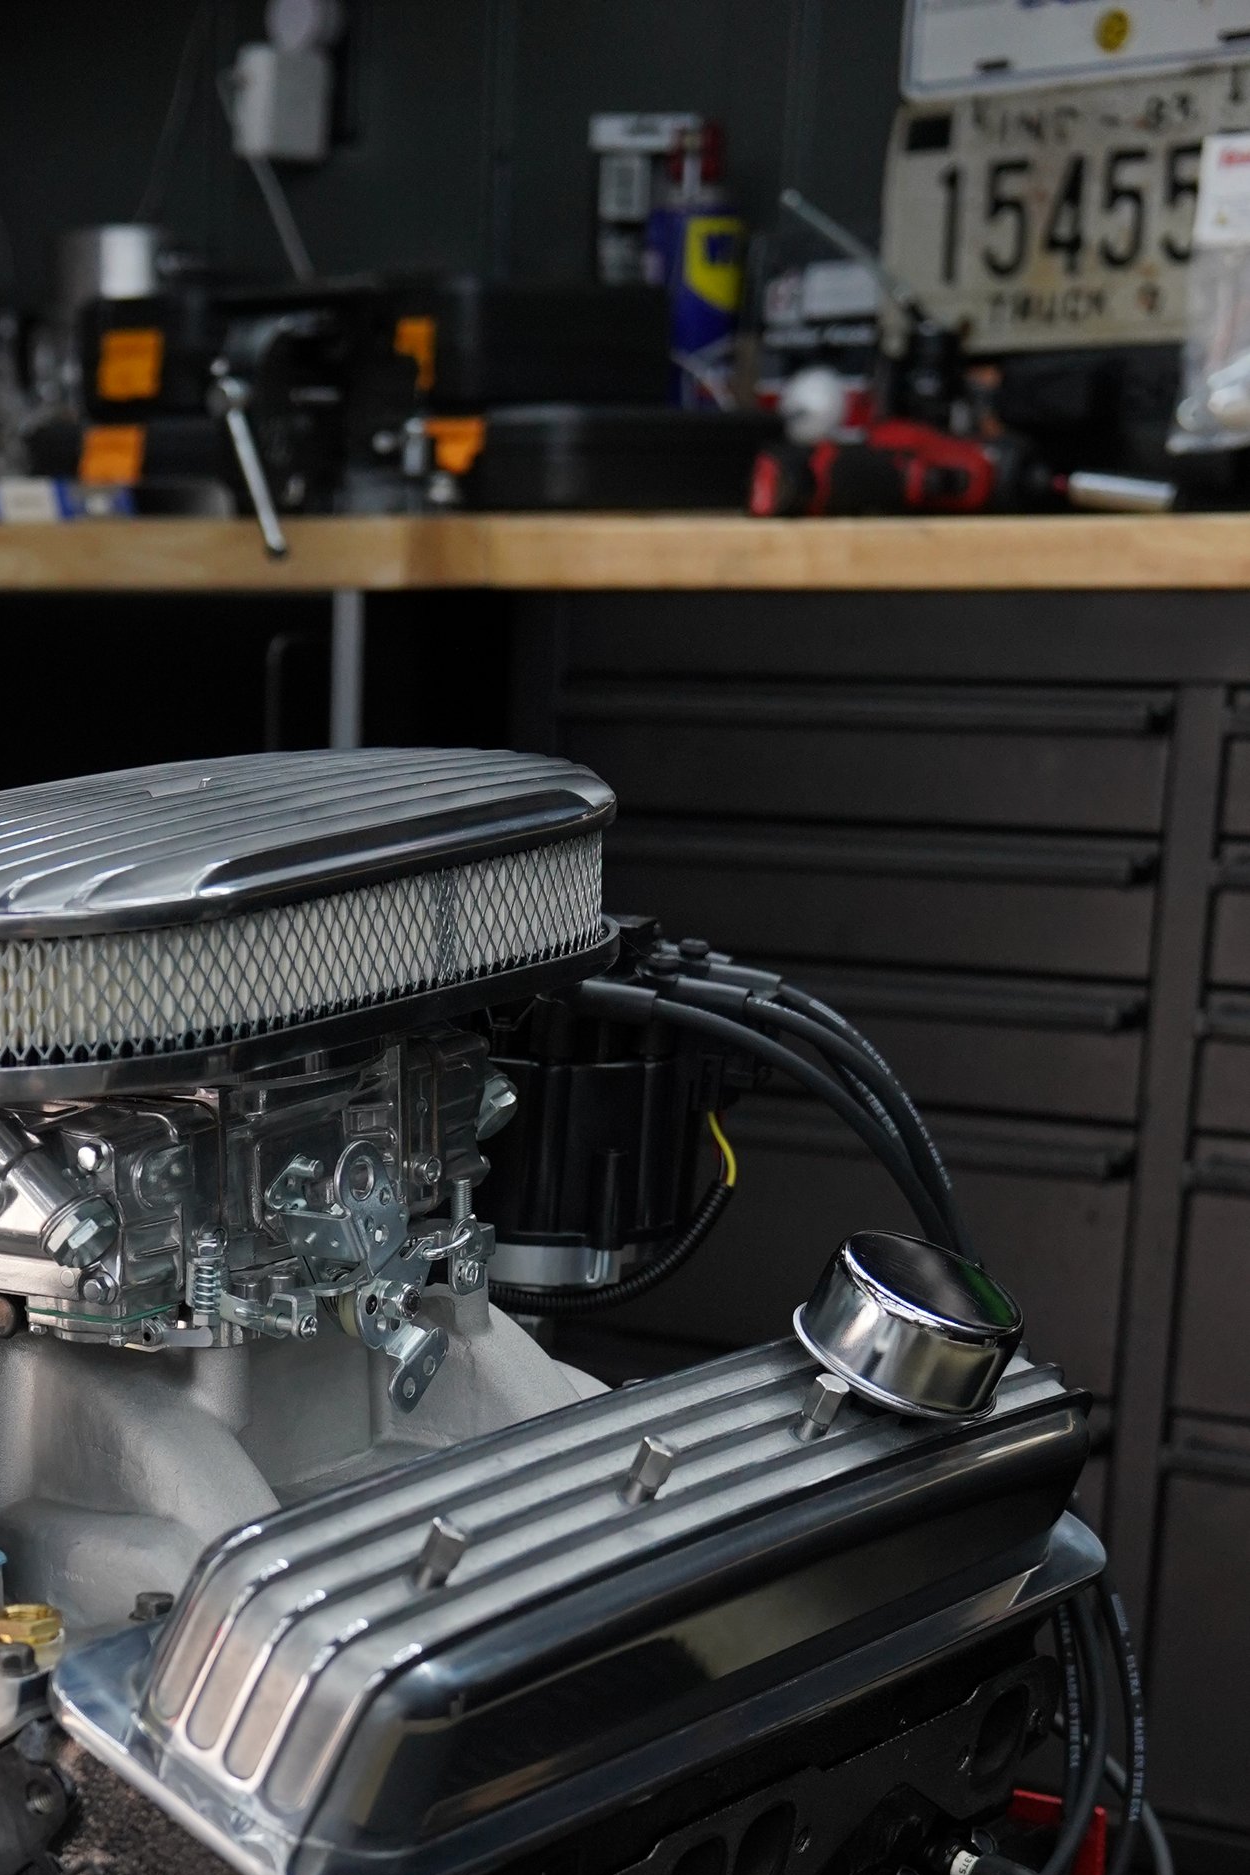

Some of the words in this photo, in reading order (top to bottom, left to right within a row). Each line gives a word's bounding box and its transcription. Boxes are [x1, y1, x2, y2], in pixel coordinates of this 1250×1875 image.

[939, 145, 1204, 288] 15455
[1125, 1654, 1143, 1697] ULTRA
[1133, 1716, 1145, 1752] MADE
